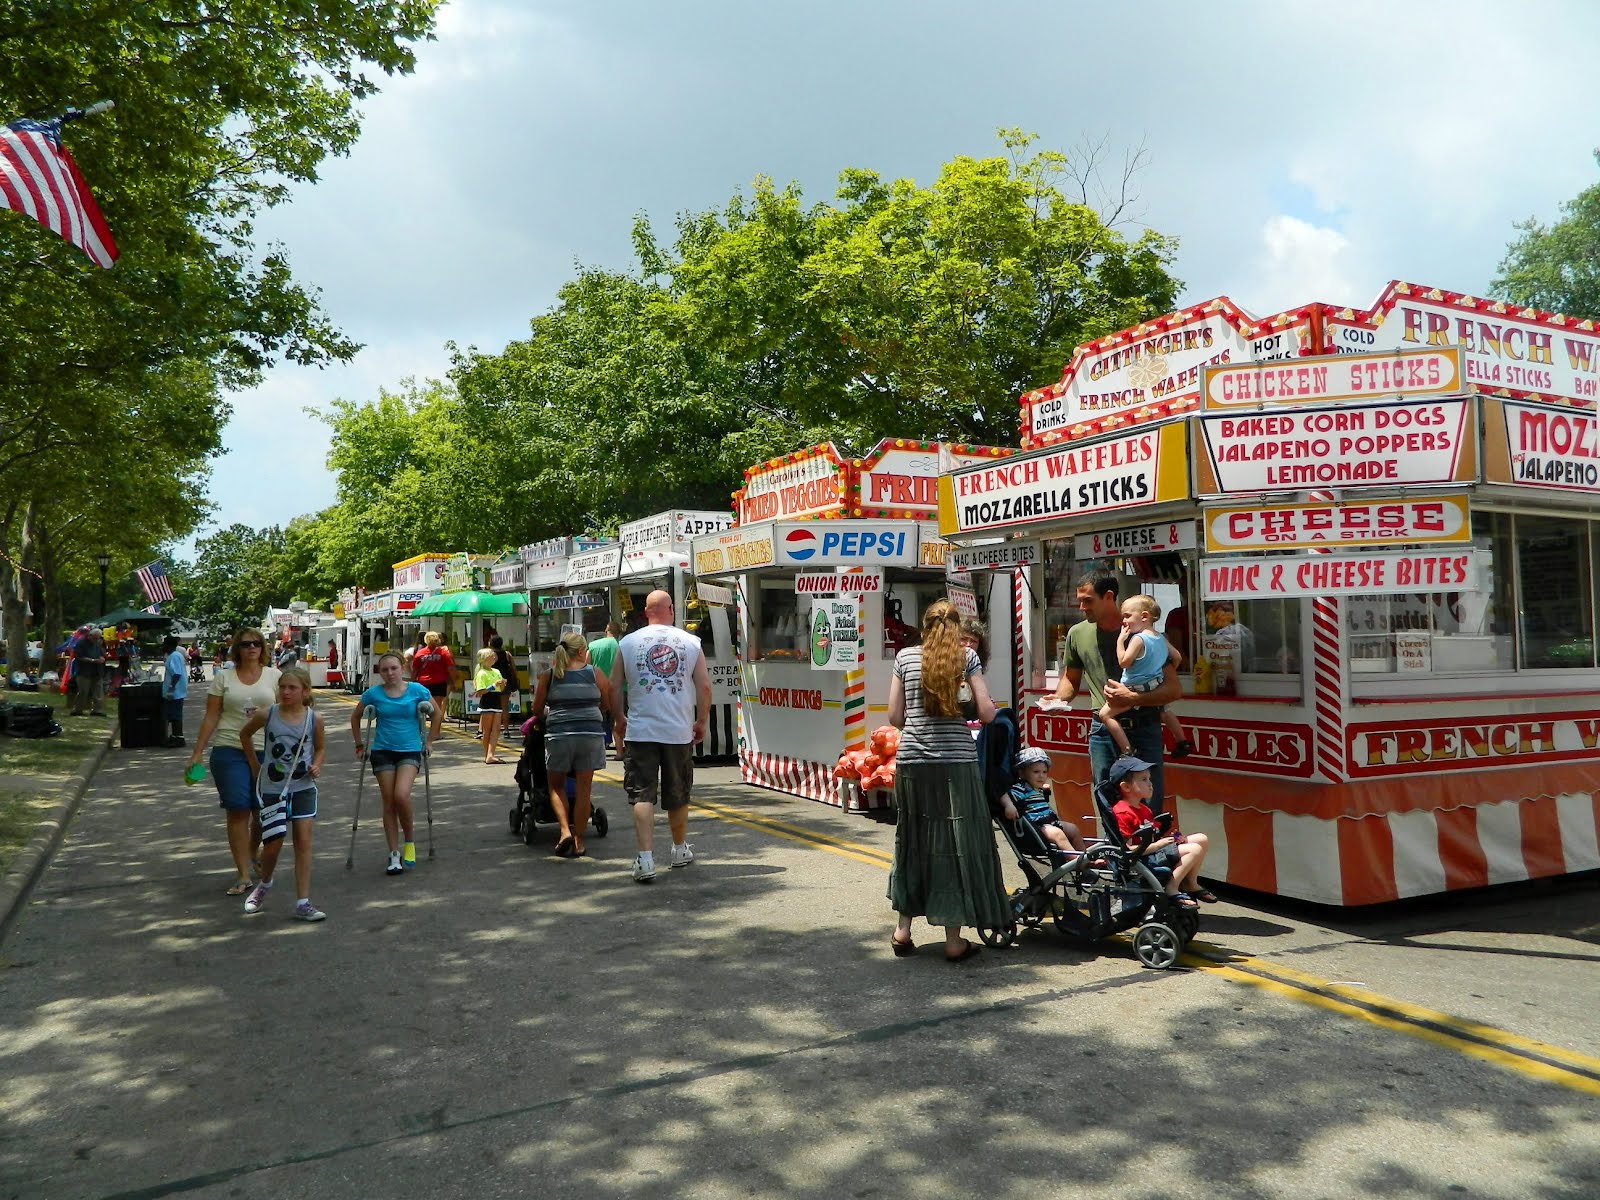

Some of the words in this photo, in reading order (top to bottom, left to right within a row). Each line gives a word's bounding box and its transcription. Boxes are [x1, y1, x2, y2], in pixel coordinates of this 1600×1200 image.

[1254, 335, 1281, 354] HOT
[1343, 328, 1375, 345] COLD
[1400, 307, 1554, 365] FRENCH
[1090, 327, 1213, 381] GITTINGER'S
[1079, 388, 1145, 411] FRENCH
[1151, 348, 1231, 398] WAFFS
[1222, 367, 1328, 401] CHICKEN
[1350, 358, 1440, 391] STICKS
[1467, 360, 1500, 382] ELLA
[1506, 367, 1552, 389] STICKS
[1040, 400, 1062, 415] COLD
[1036, 413, 1067, 431] DRINKS
[1221, 416, 1295, 438] BAKED
[1303, 411, 1365, 433] CORN
[1374, 406, 1446, 429] DOGS
[1217, 438, 1330, 463] JALAPENO
[1339, 430, 1451, 455] POPPERS
[1512, 452, 1526, 464] HOT
[959, 460, 1038, 497] FRENCH
[1045, 435, 1153, 479] WAFFLES
[1267, 459, 1399, 485] LEMONADE
[1519, 457, 1598, 486] JALAPENO
[742, 491, 779, 525] FRIED
[780, 474, 839, 516] VEGGIES
[964, 487, 1071, 527] MOZZARELLA
[1078, 473, 1149, 507] STICKS
[1228, 503, 1445, 540] CHEESE
[822, 532, 906, 556] PEPSI
[1093, 535, 1102, 554] &
[1105, 528, 1157, 549] CHEESE
[1265, 533, 1297, 542] ON
[1311, 532, 1326, 540] A
[1340, 528, 1409, 539] STICK
[696, 549, 724, 574] FRIED
[727, 537, 773, 569] VEGGIES
[954, 553, 970, 567] MAC
[972, 551, 978, 565] &
[978, 548, 1010, 564] CHEESE
[1012, 545, 1035, 561] BITES
[797, 576, 837, 592] ONION
[841, 575, 880, 592] RINGS
[1209, 564, 1260, 593] MAC
[1296, 559, 1385, 589] CHEESE
[1396, 555, 1468, 586] BITES
[399, 593, 425, 601] PEPSI
[831, 602, 855, 617] Deep
[834, 615, 856, 629] Fried
[1402, 650, 1415, 658] On
[1416, 649, 1424, 658] A
[1403, 660, 1425, 669] Stick
[759, 687, 790, 708] ONION
[791, 688, 823, 711] RINGS
[1365, 722, 1556, 766] FRENCH
